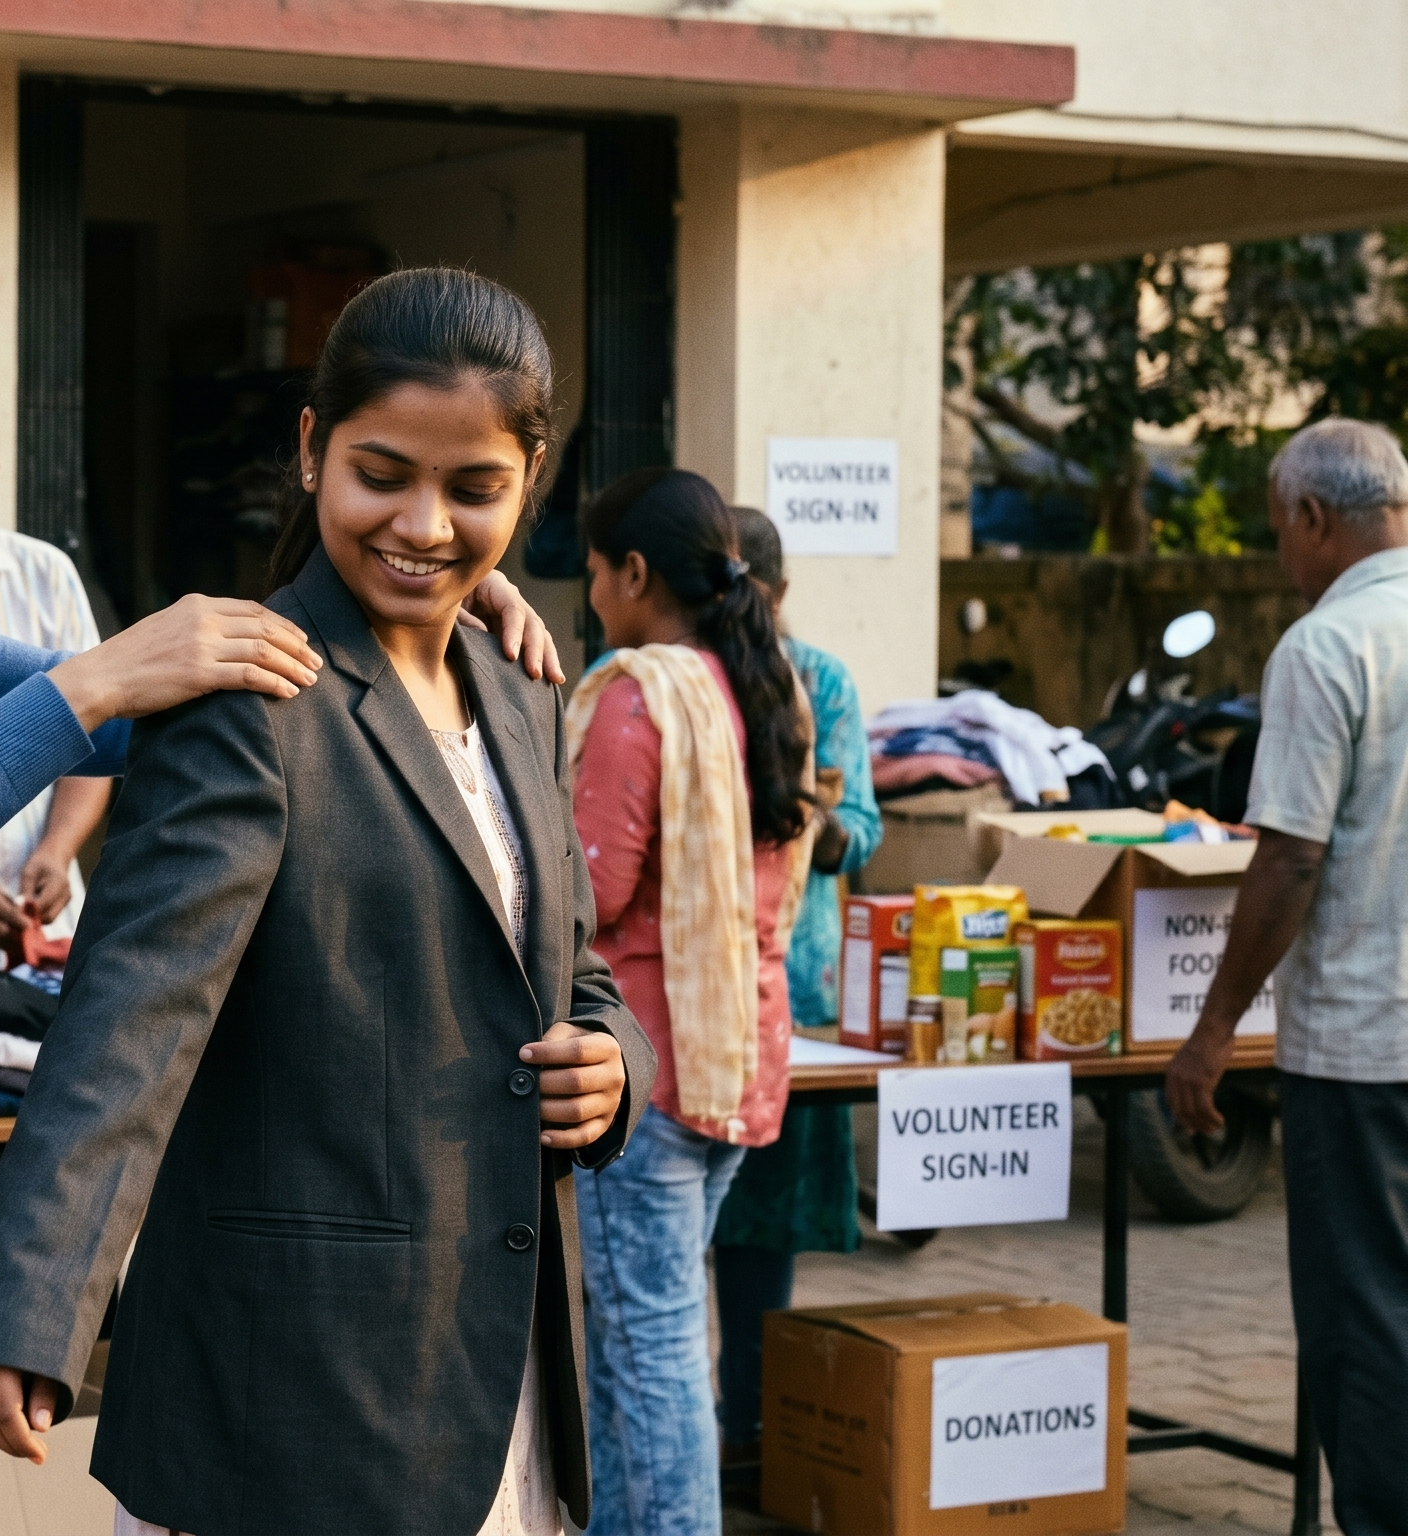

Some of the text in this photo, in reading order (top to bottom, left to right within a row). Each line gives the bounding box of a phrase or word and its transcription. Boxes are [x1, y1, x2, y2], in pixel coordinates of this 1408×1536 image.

[772, 462, 891, 484] VOLUNTEER
[785, 498, 879, 523] SIGN-IN
[892, 1102, 1059, 1136] VOLUNTEER
[922, 1150, 1029, 1181] SIGN-IN
[945, 1403, 1096, 1442] DONATIONS
